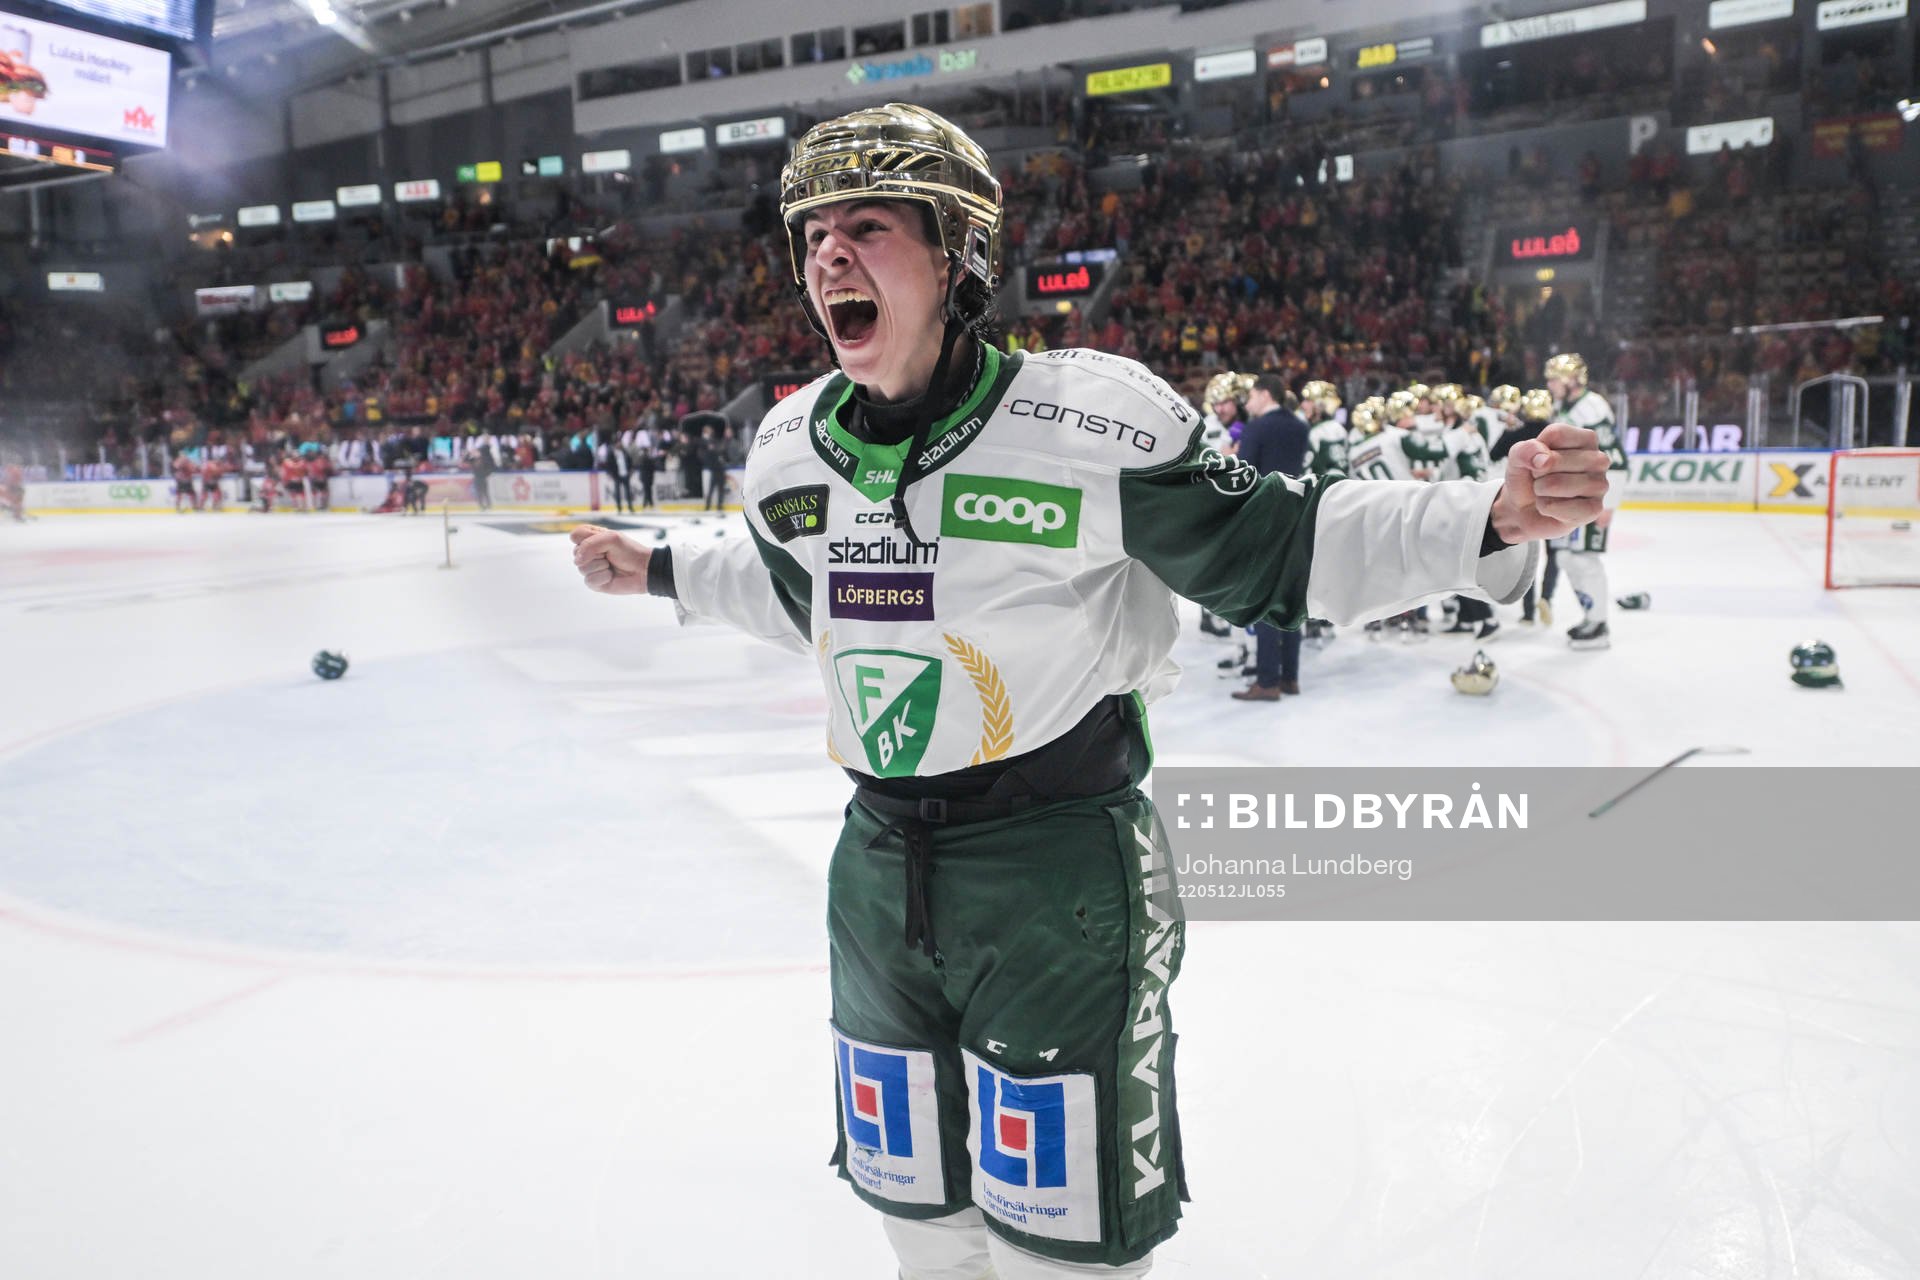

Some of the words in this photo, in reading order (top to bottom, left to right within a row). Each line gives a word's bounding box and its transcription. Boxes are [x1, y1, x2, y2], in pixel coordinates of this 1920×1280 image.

[815, 418, 850, 468] stadium
[918, 416, 982, 471] stadium
[863, 470, 897, 485] SHL
[1637, 460, 1743, 483] KOKI
[1814, 473, 1906, 488] AELENT
[953, 491, 1067, 535] coop
[828, 536, 938, 565] stadium
[837, 586, 925, 607] LÖFBERGS
